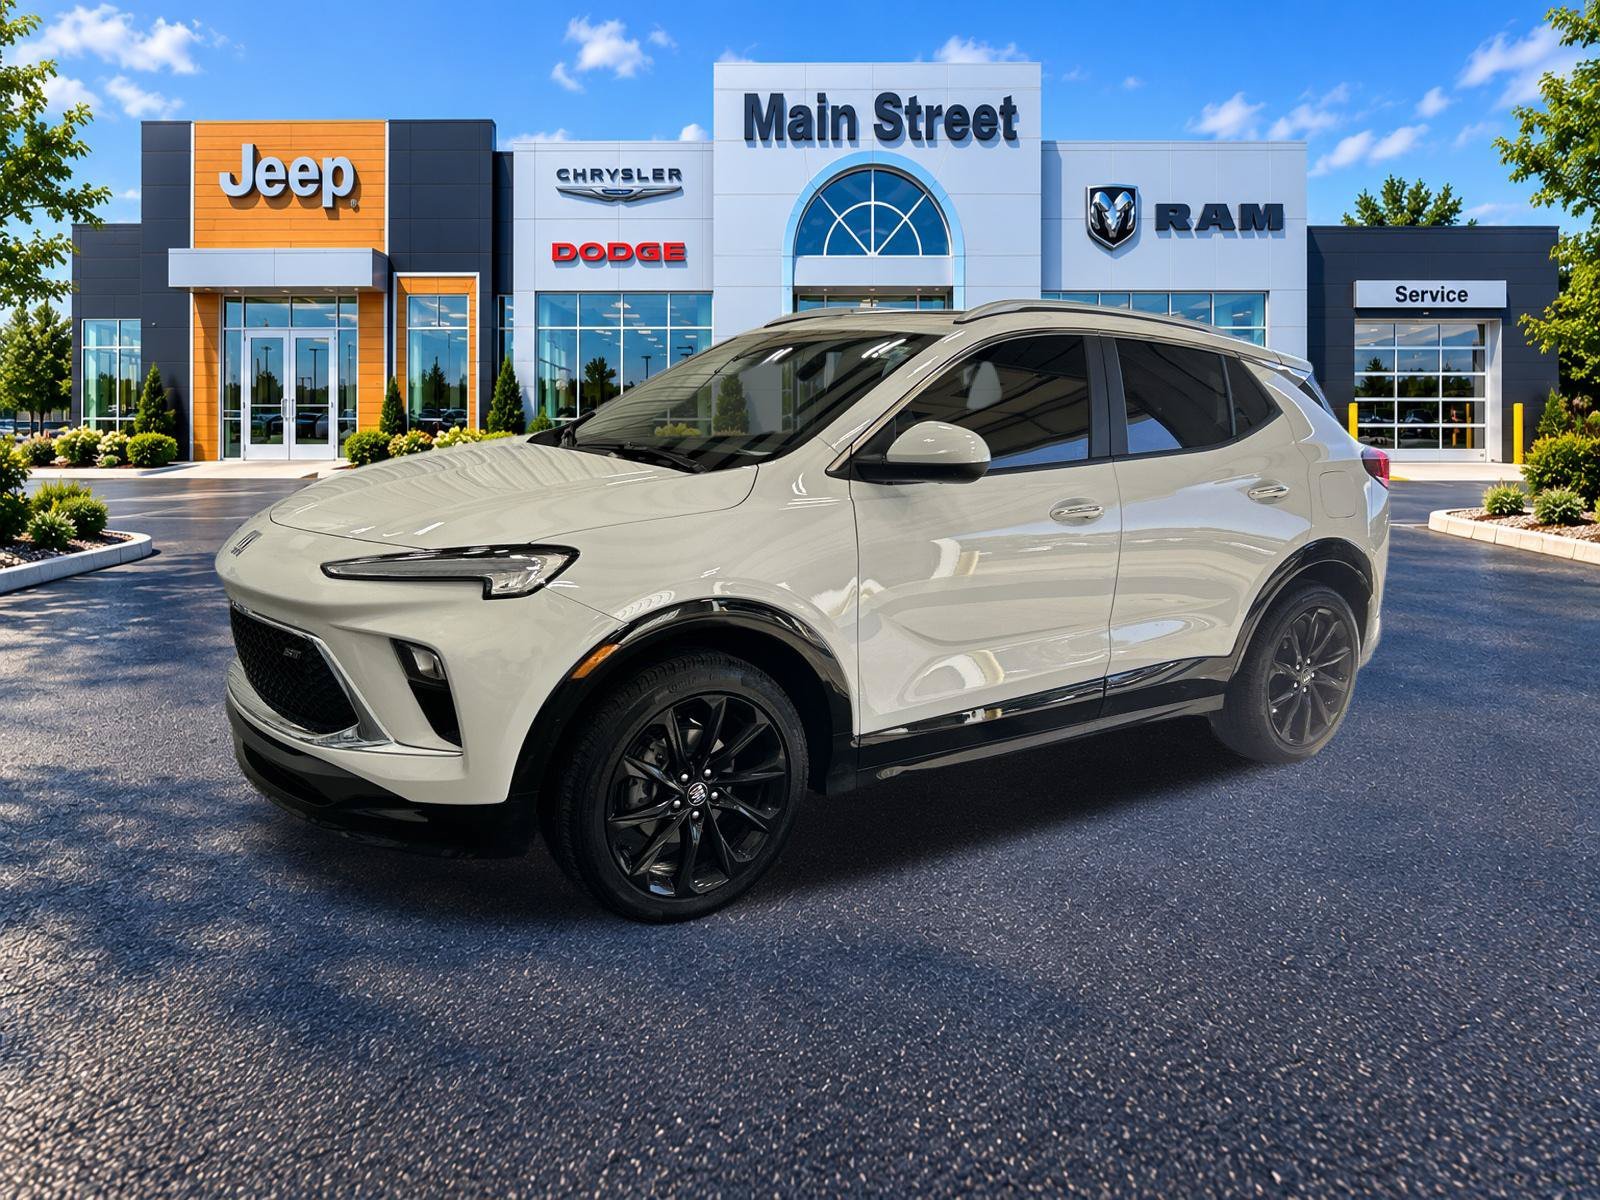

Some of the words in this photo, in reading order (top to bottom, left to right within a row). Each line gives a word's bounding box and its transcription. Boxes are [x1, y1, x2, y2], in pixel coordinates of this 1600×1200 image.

[744, 92, 856, 141] Main
[873, 91, 1017, 141] Street
[219, 143, 355, 208] Jeep
[556, 167, 683, 182] CHRYSLER
[1155, 203, 1284, 231] RAM
[551, 242, 686, 261] DODGE
[1395, 285, 1469, 303] Service
